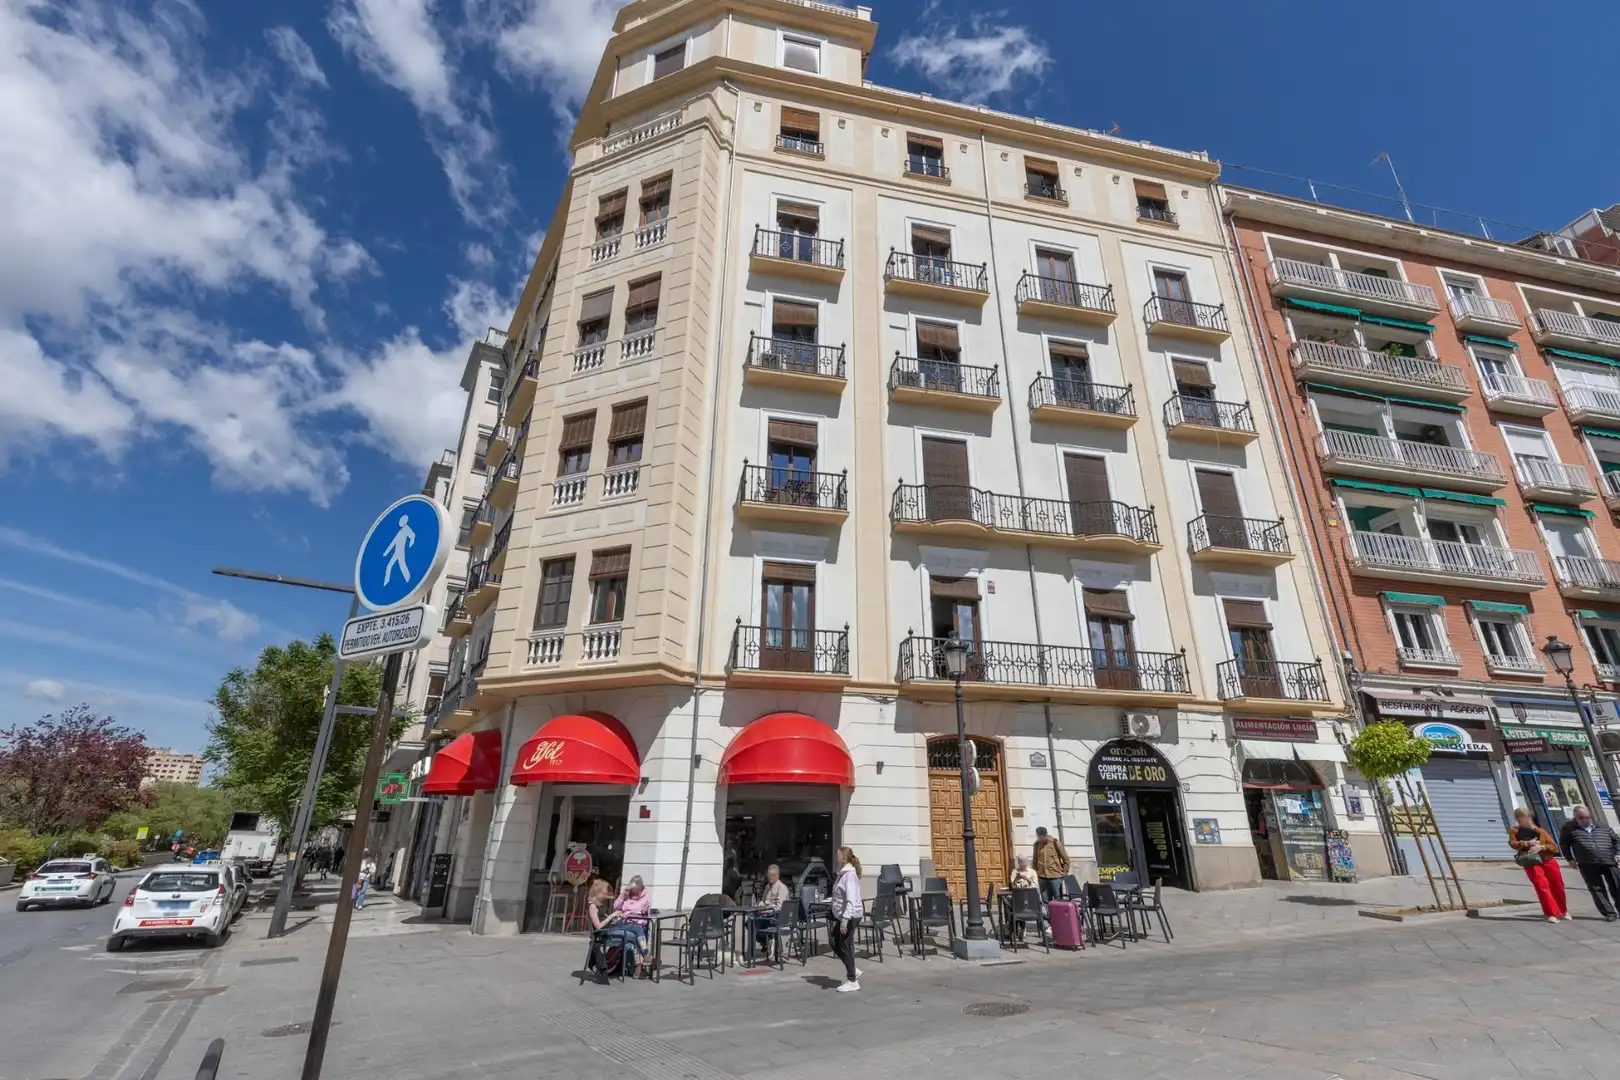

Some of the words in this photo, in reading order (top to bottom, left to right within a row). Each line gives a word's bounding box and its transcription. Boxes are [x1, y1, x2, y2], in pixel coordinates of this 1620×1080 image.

[356, 620, 379, 634] EXPTE.
[344, 634, 371, 650] PERMITIDO
[382, 625, 419, 642] AUTORIZADOS
[1381, 701, 1443, 713] RESTAURANTE
[1449, 705, 1485, 715] ASADOR
[1235, 721, 1291, 731] ALIMENTACIÓN
[1292, 723, 1315, 732] LUCÍA
[1097, 764, 1128, 773] COMPRA
[1128, 765, 1143, 781] DE
[1144, 765, 1166, 782] ORO
[1099, 772, 1129, 780] VENTA
